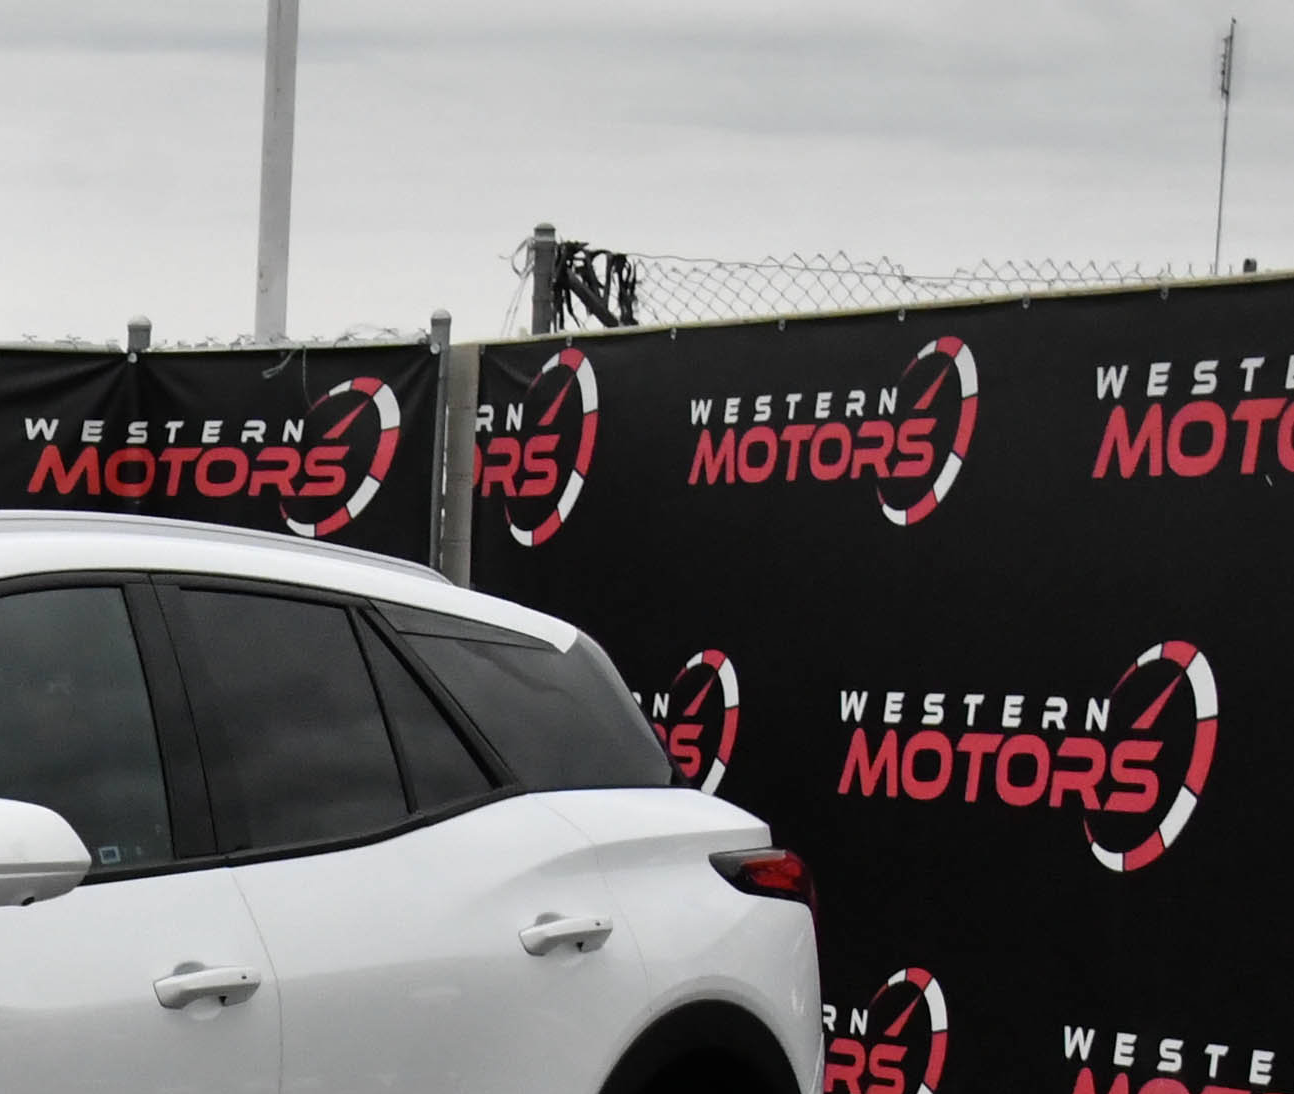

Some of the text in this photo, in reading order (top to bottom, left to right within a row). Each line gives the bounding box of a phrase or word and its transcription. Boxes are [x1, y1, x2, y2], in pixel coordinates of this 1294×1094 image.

[25, 418, 304, 443] WESTERN
[691, 388, 897, 424] WESTERN
[689, 418, 936, 485] MOTORS
[1093, 398, 1294, 478] MOT
[29, 445, 349, 496] MOTORS
[841, 691, 1110, 731] WESTERN
[838, 728, 1163, 813] MOTORS
